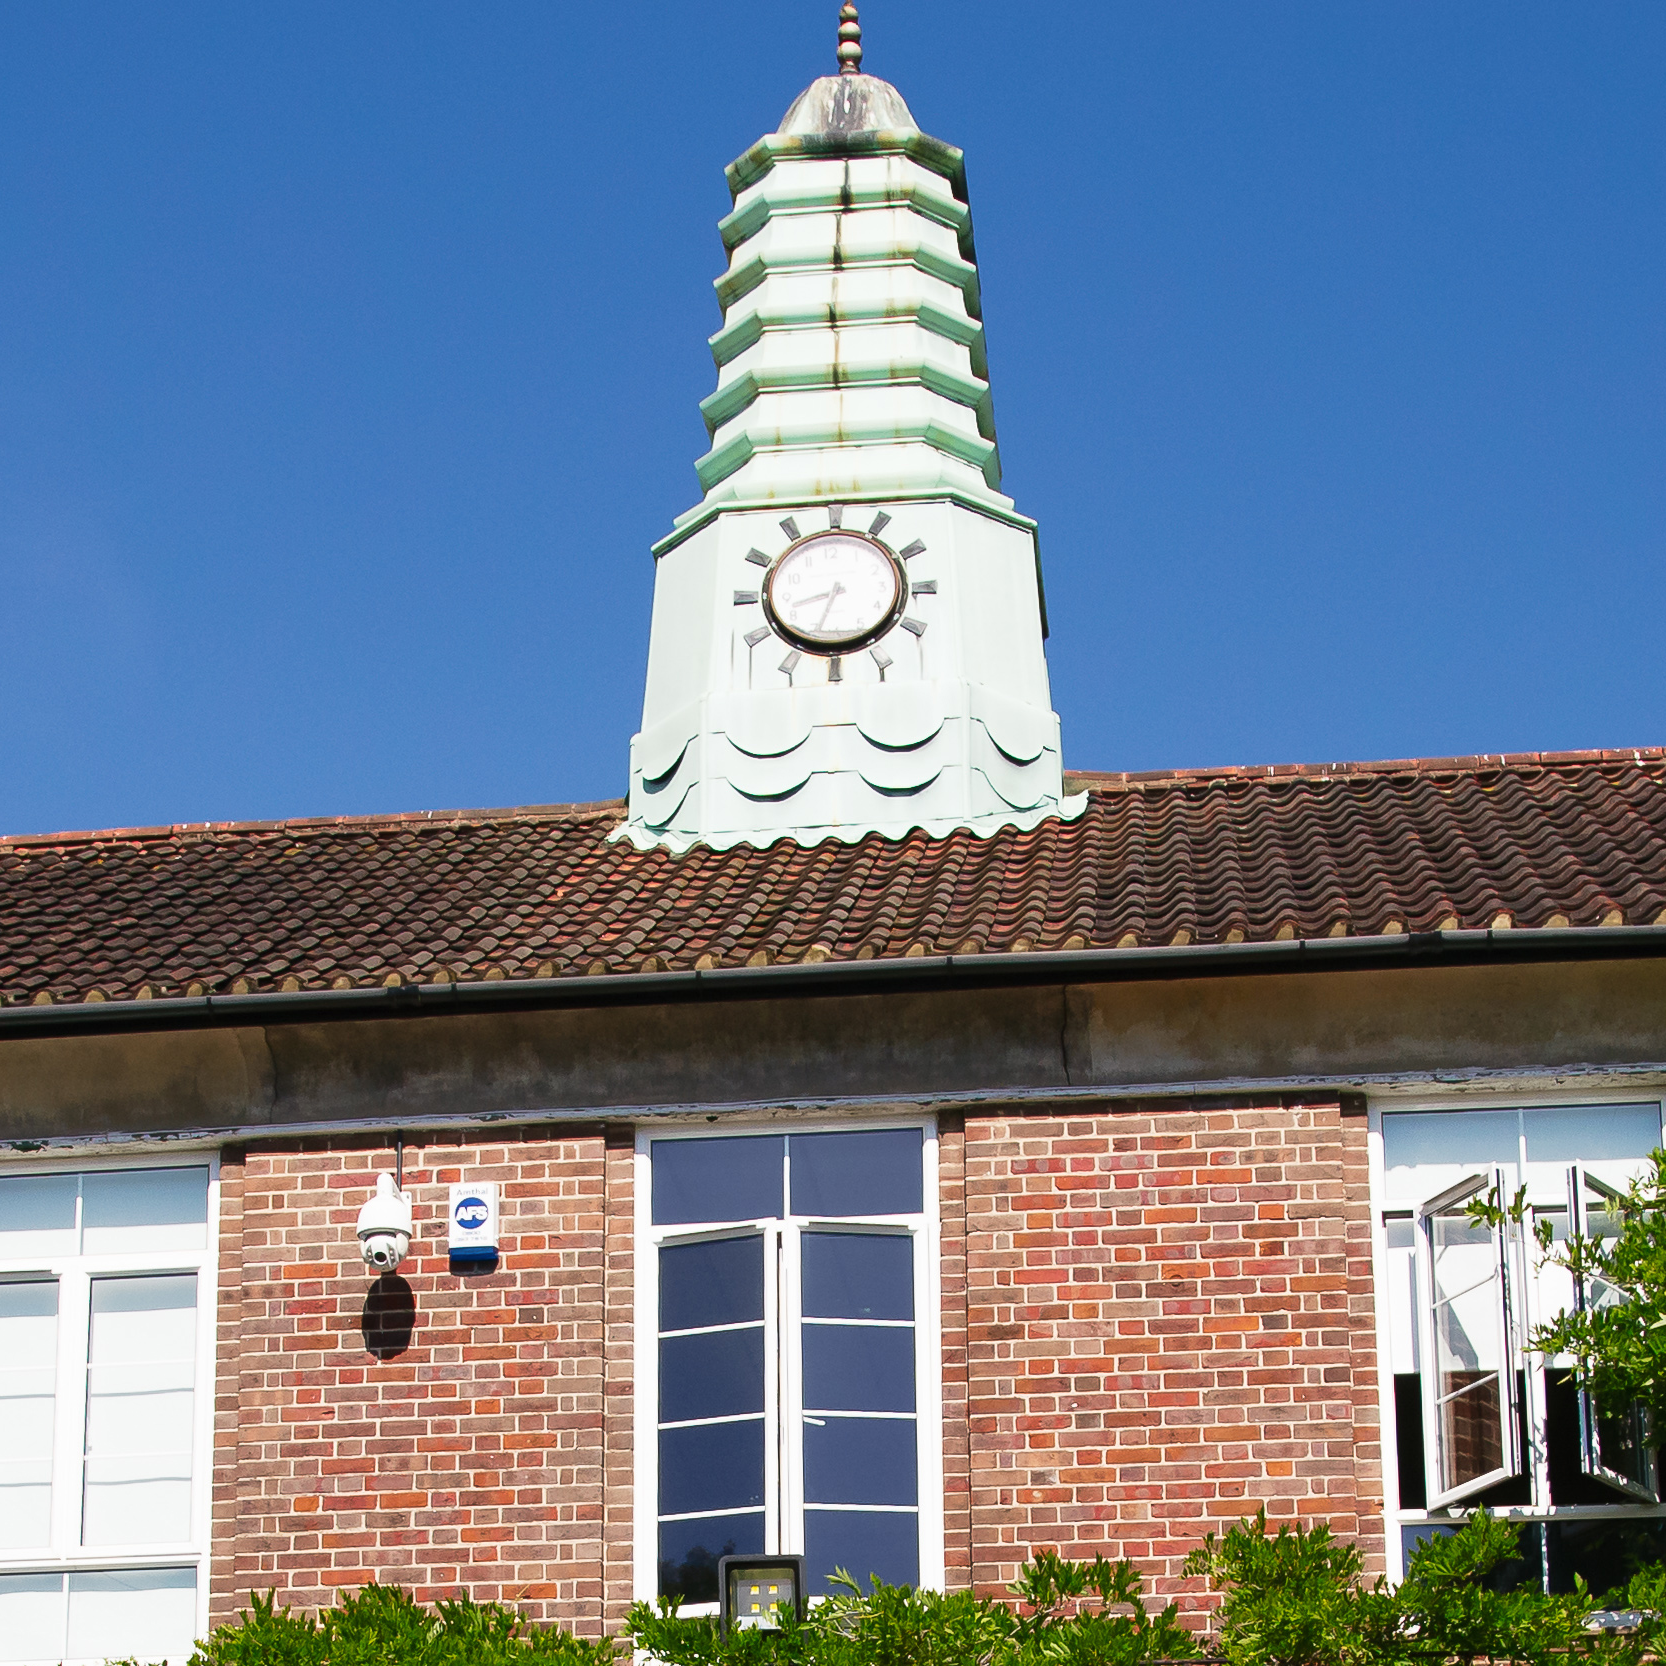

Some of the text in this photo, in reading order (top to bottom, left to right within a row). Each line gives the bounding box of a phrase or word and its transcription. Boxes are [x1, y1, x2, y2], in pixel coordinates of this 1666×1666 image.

[824, 547, 838, 560] 12
[855, 549, 858, 562] 1
[805, 556, 812, 568] 11
[871, 564, 879, 576] 2
[788, 573, 800, 585] 10
[879, 581, 886, 593] 3
[782, 592, 791, 603] 9
[873, 600, 881, 611] 4
[790, 610, 797, 621] 8
[857, 617, 865, 630] 5
[455, 1206, 488, 1221] AFS
